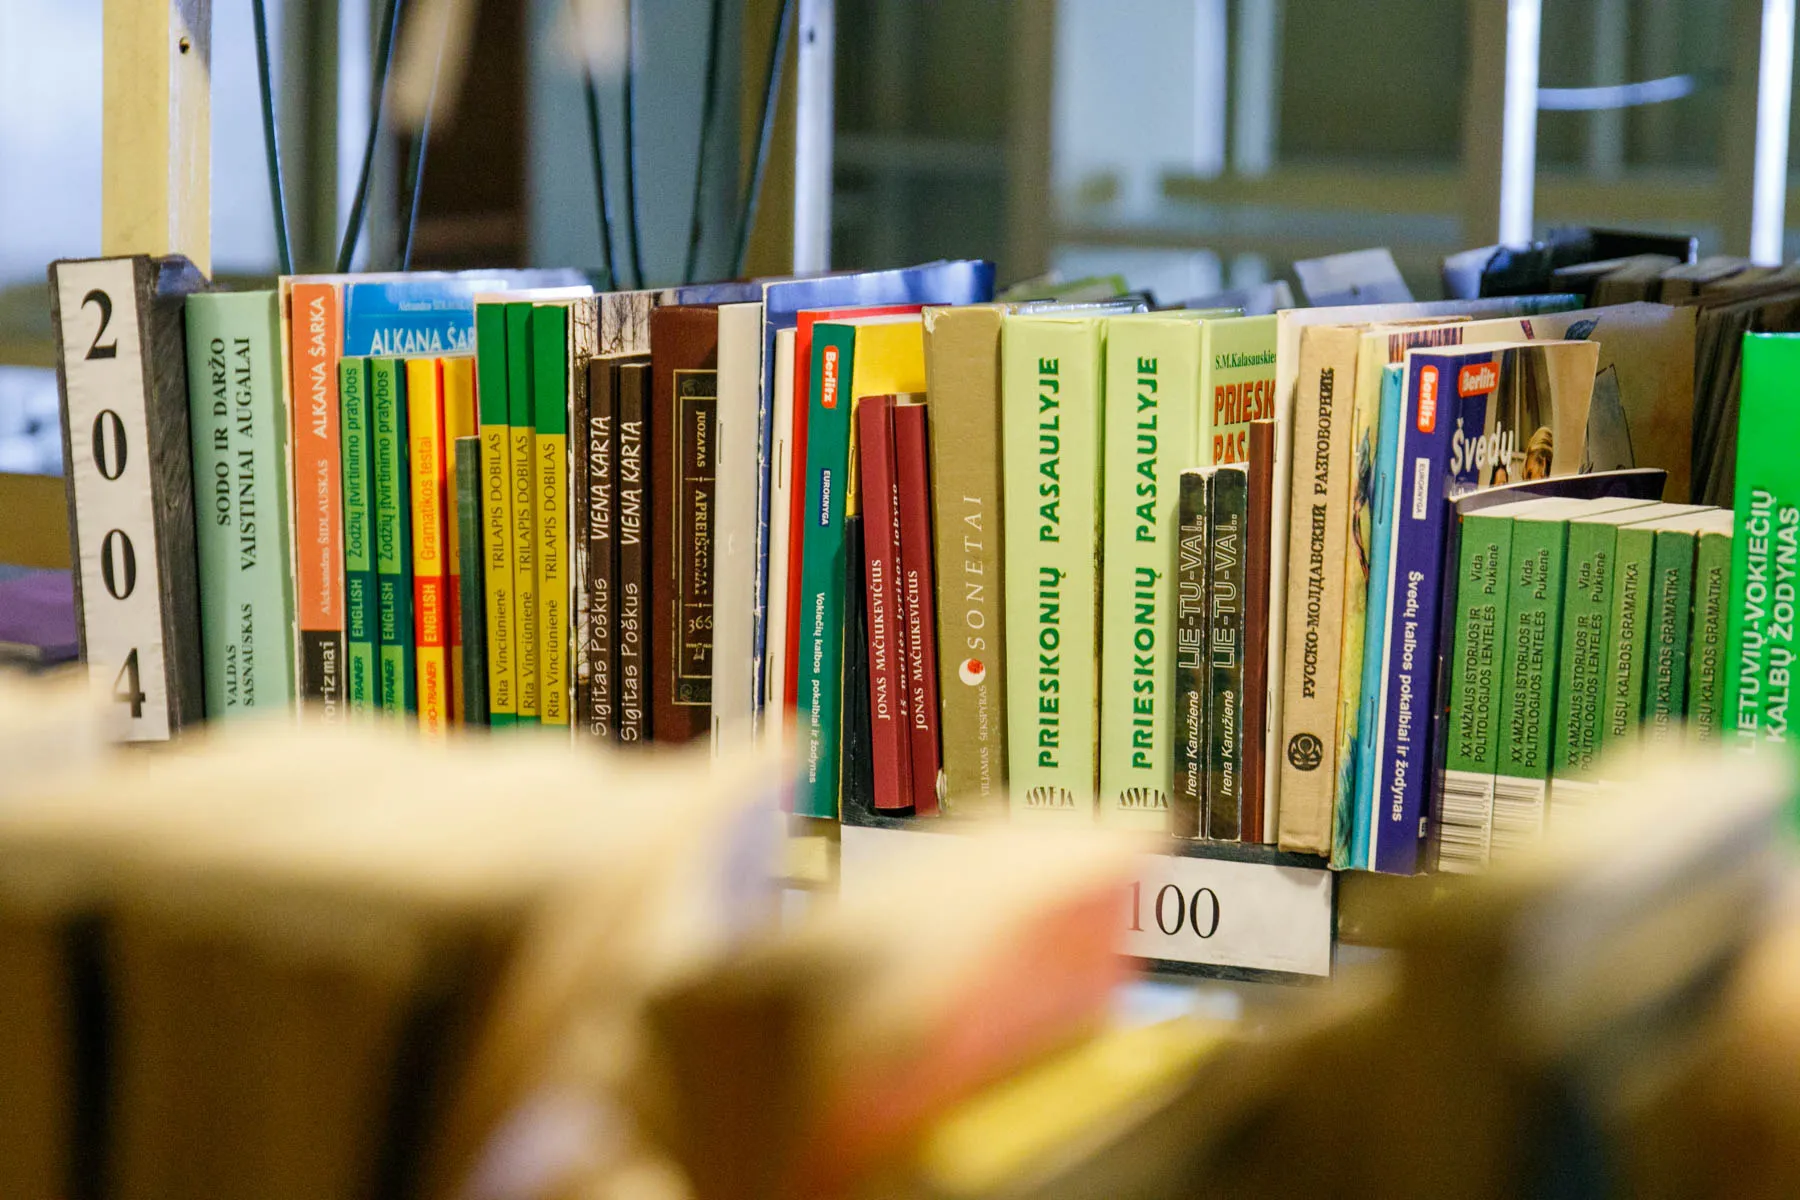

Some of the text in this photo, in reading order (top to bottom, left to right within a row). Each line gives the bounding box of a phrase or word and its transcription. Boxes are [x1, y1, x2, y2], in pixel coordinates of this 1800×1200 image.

[308, 296, 328, 439] ALKANA ŠARKA
[370, 327, 443, 356] ALKANA
[1215, 350, 1276, 371] S.M.Kalasauskie
[345, 368, 361, 430] pratybos
[376, 370, 392, 432] pratybos
[824, 351, 837, 403] Berlitz
[1420, 371, 1437, 427] Berlitz
[1463, 366, 1496, 392] Berlitz
[208, 337, 231, 526] SODO IR DARŽO
[234, 337, 257, 572] VAISTINIAI AUGALAI
[417, 436, 432, 475] testai
[696, 410, 706, 468] JUOZAPAS
[1450, 417, 1514, 477] Švedų
[316, 459, 331, 544] ŠIDLAUSKAS
[347, 434, 364, 507] įtvirtinimo
[378, 438, 395, 511] įtvirtinimo
[591, 416, 612, 541] VIENA KARTA
[621, 421, 642, 545] VIENA KARTA
[821, 469, 831, 526] EUROKNYGA
[1415, 462, 1426, 514] EUROKNYGA
[349, 511, 363, 559] Žodžių
[379, 514, 394, 562] Žodžių
[420, 479, 436, 560] Gramatikos
[892, 483, 901, 547] lobyno
[1302, 366, 1334, 699] РУССКО-МОЛДАВСКИЙ РАЗГОВОРНИК
[488, 433, 508, 707] Rita Vinciūnienė TRILAPIS DOBILAS
[516, 435, 535, 709] Rita Vinciūnienė TRILAPIS DOBILAS
[543, 443, 560, 718] Rita Vinciūnienė TRILAPIS DOBILAS
[896, 557, 905, 620] lyrikos
[963, 495, 985, 650] SONETAI
[1038, 357, 1067, 768] PRIESKONIŲ PASAULYJE
[1132, 356, 1162, 769] PRIESKONIŲ PASAULYJE
[1471, 554, 1483, 583] Vida
[1484, 544, 1499, 595] Pukienė
[1521, 559, 1534, 588] Vida
[1535, 549, 1549, 600] Pukienė
[1579, 562, 1591, 591] Vida
[1592, 551, 1606, 603] Pukienė
[351, 579, 364, 637] ENGLISH
[382, 582, 394, 640] ENGLISH
[422, 584, 437, 642] ENGLISH
[813, 592, 825, 637] Vokiečių
[869, 559, 890, 720] JONAS MAČIUKEVIČIUS
[1662, 567, 1680, 645] GRAMATIKA
[1705, 566, 1723, 645] GRAMATIKA
[1764, 506, 1800, 744] KALBŲ ŽODYNAS
[226, 644, 237, 708] VALDAS
[241, 603, 255, 707] SASNAUSKAS
[591, 577, 612, 737] Sigitas Poškus
[621, 583, 642, 742] Sigitas Poškus
[813, 639, 823, 674] kalbos
[907, 570, 928, 730] JONAS MAČIUKEVIČIUS
[1588, 613, 1603, 676] LENTELĖS
[1613, 562, 1639, 736] RUSŲ KALBOS GRAMATIKA
[1658, 645, 1674, 705] KALBOS
[1701, 646, 1718, 703] KALBOS
[811, 679, 822, 726] pokalbiai
[1391, 571, 1424, 822] Švedų kalbos pokalbiai ir žodynas
[1460, 607, 1481, 758] XX AMŽIAUS ISTORIJOS IR
[1475, 605, 1496, 763] POLITOLOGIJOS LENTELĖS
[1510, 612, 1531, 764] XX AMŽIAUS ISTORIJOS IR
[1525, 610, 1546, 768] POLITOLOGIJOS LENTELĖS
[1567, 616, 1588, 767] XX AMŽIAUS ISTORIJOS IR
[808, 738, 822, 783] žodynas
[1185, 690, 1199, 797] Irena Karužienė
[1220, 690, 1234, 797] Irena Karužienė
